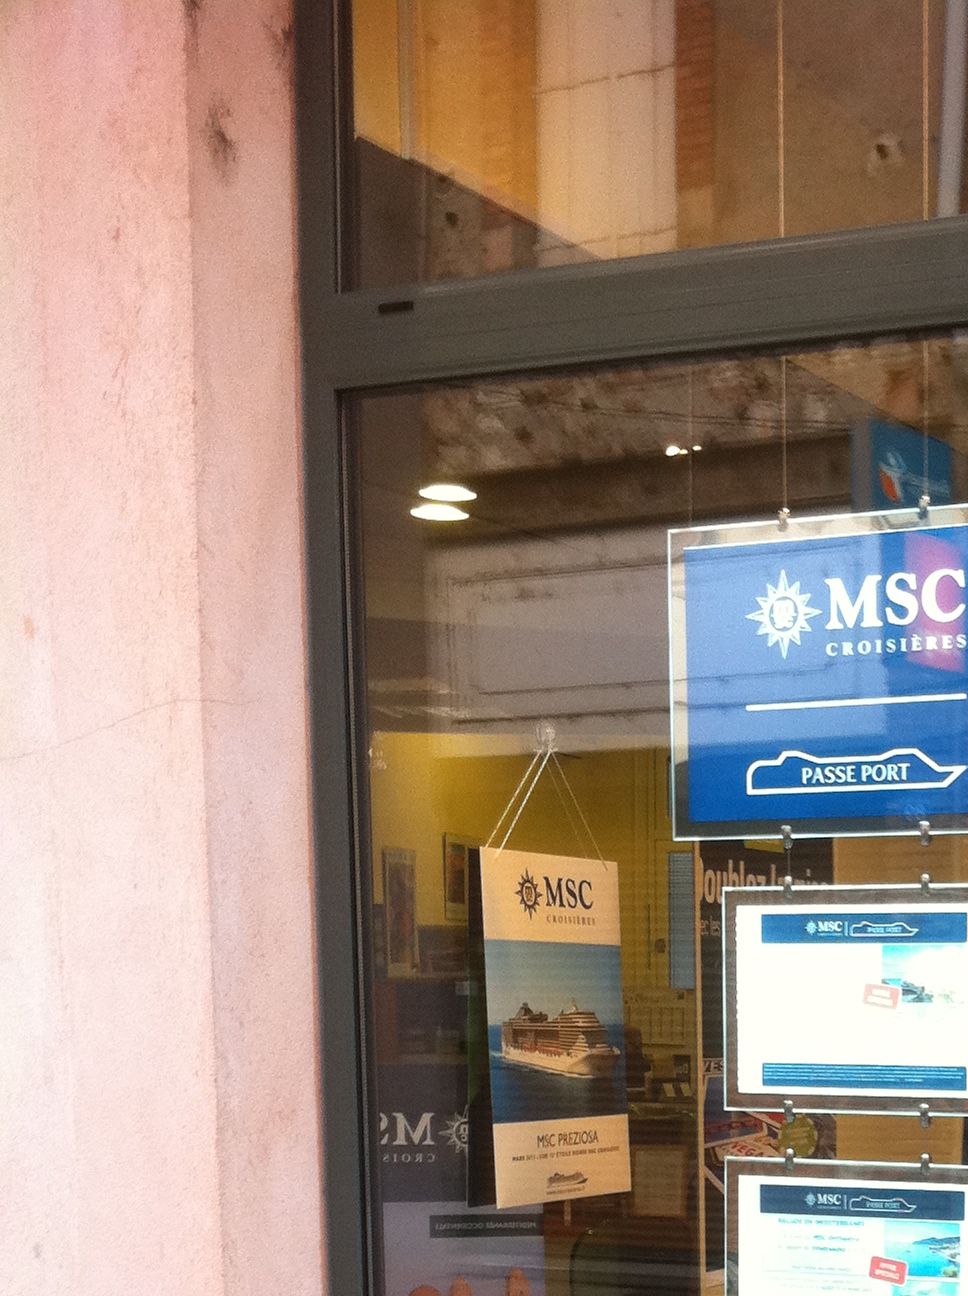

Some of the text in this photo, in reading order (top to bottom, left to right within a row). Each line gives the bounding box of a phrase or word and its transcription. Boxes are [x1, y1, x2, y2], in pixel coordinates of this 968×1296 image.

[824, 568, 966, 630] MSC
[825, 633, 968, 657] CROISIÈRES
[801, 762, 911, 785] PASSE PORT
[543, 876, 594, 910] MSC
[817, 921, 843, 932] MSC
[537, 1129, 599, 1149] MSC PREZIOSA
[817, 1193, 842, 1206] MSC
